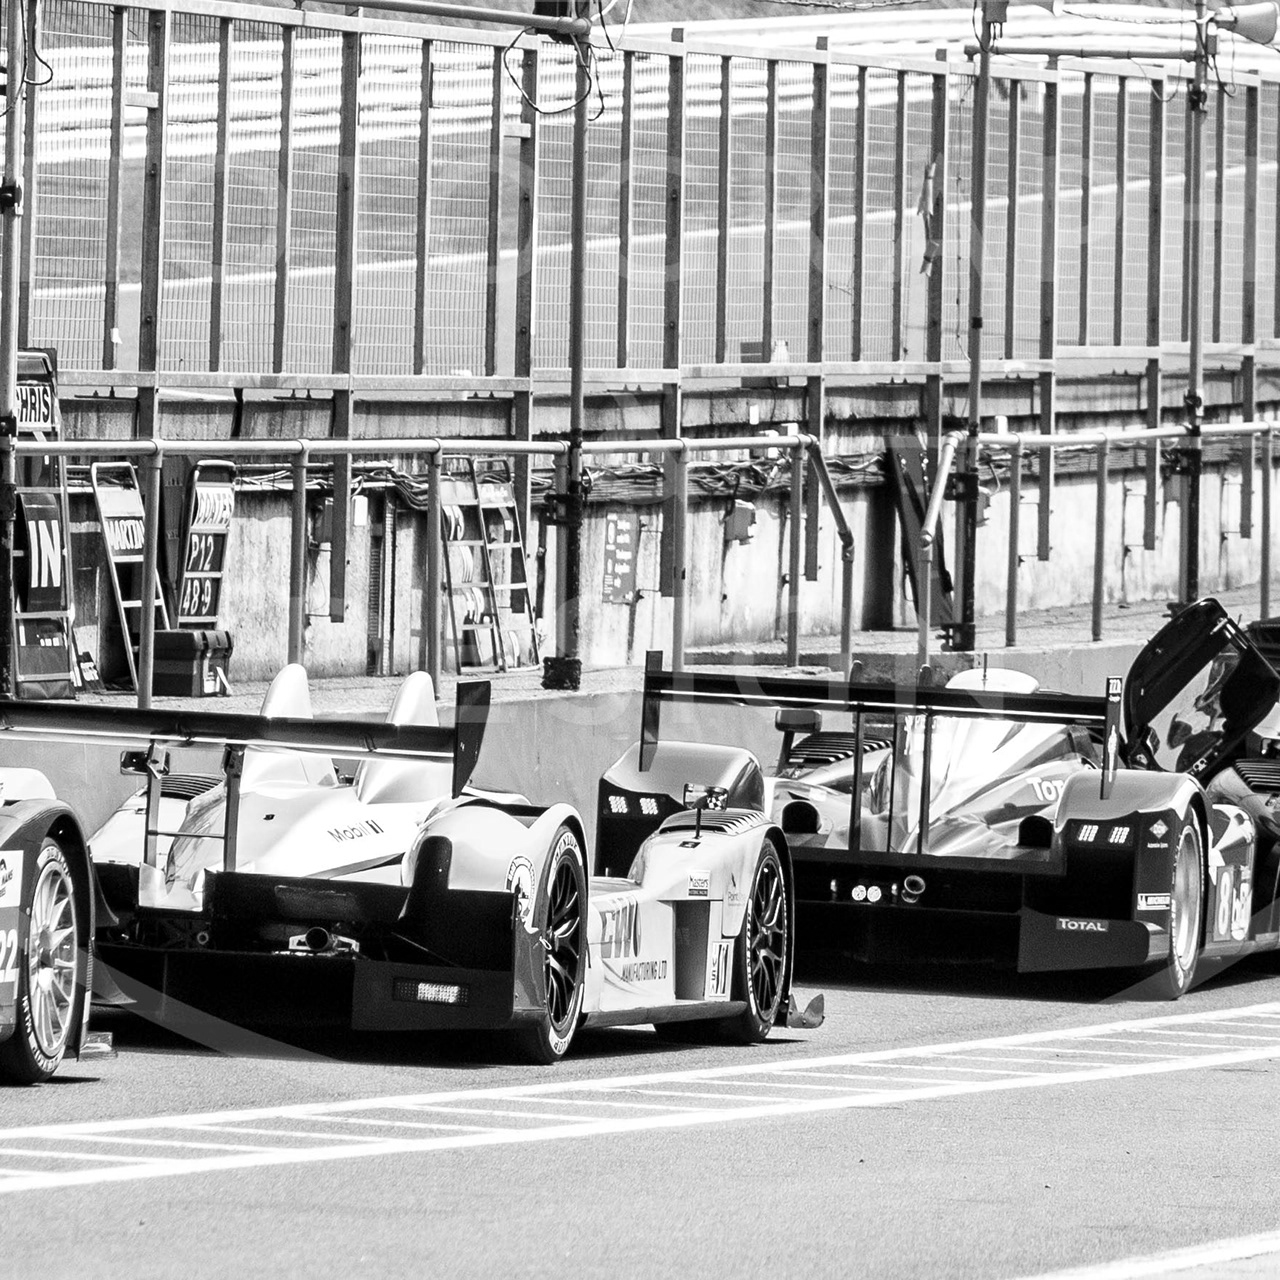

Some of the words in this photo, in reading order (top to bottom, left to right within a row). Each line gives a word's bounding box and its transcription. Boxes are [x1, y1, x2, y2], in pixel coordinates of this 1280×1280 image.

[30, 519, 62, 590] IN
[188, 534, 214, 571] P12
[327, 821, 370, 843] Mobil
[1218, 871, 1231, 936] 8
[1059, 918, 1107, 932] TOTAL
[658, 960, 668, 980] LTD
